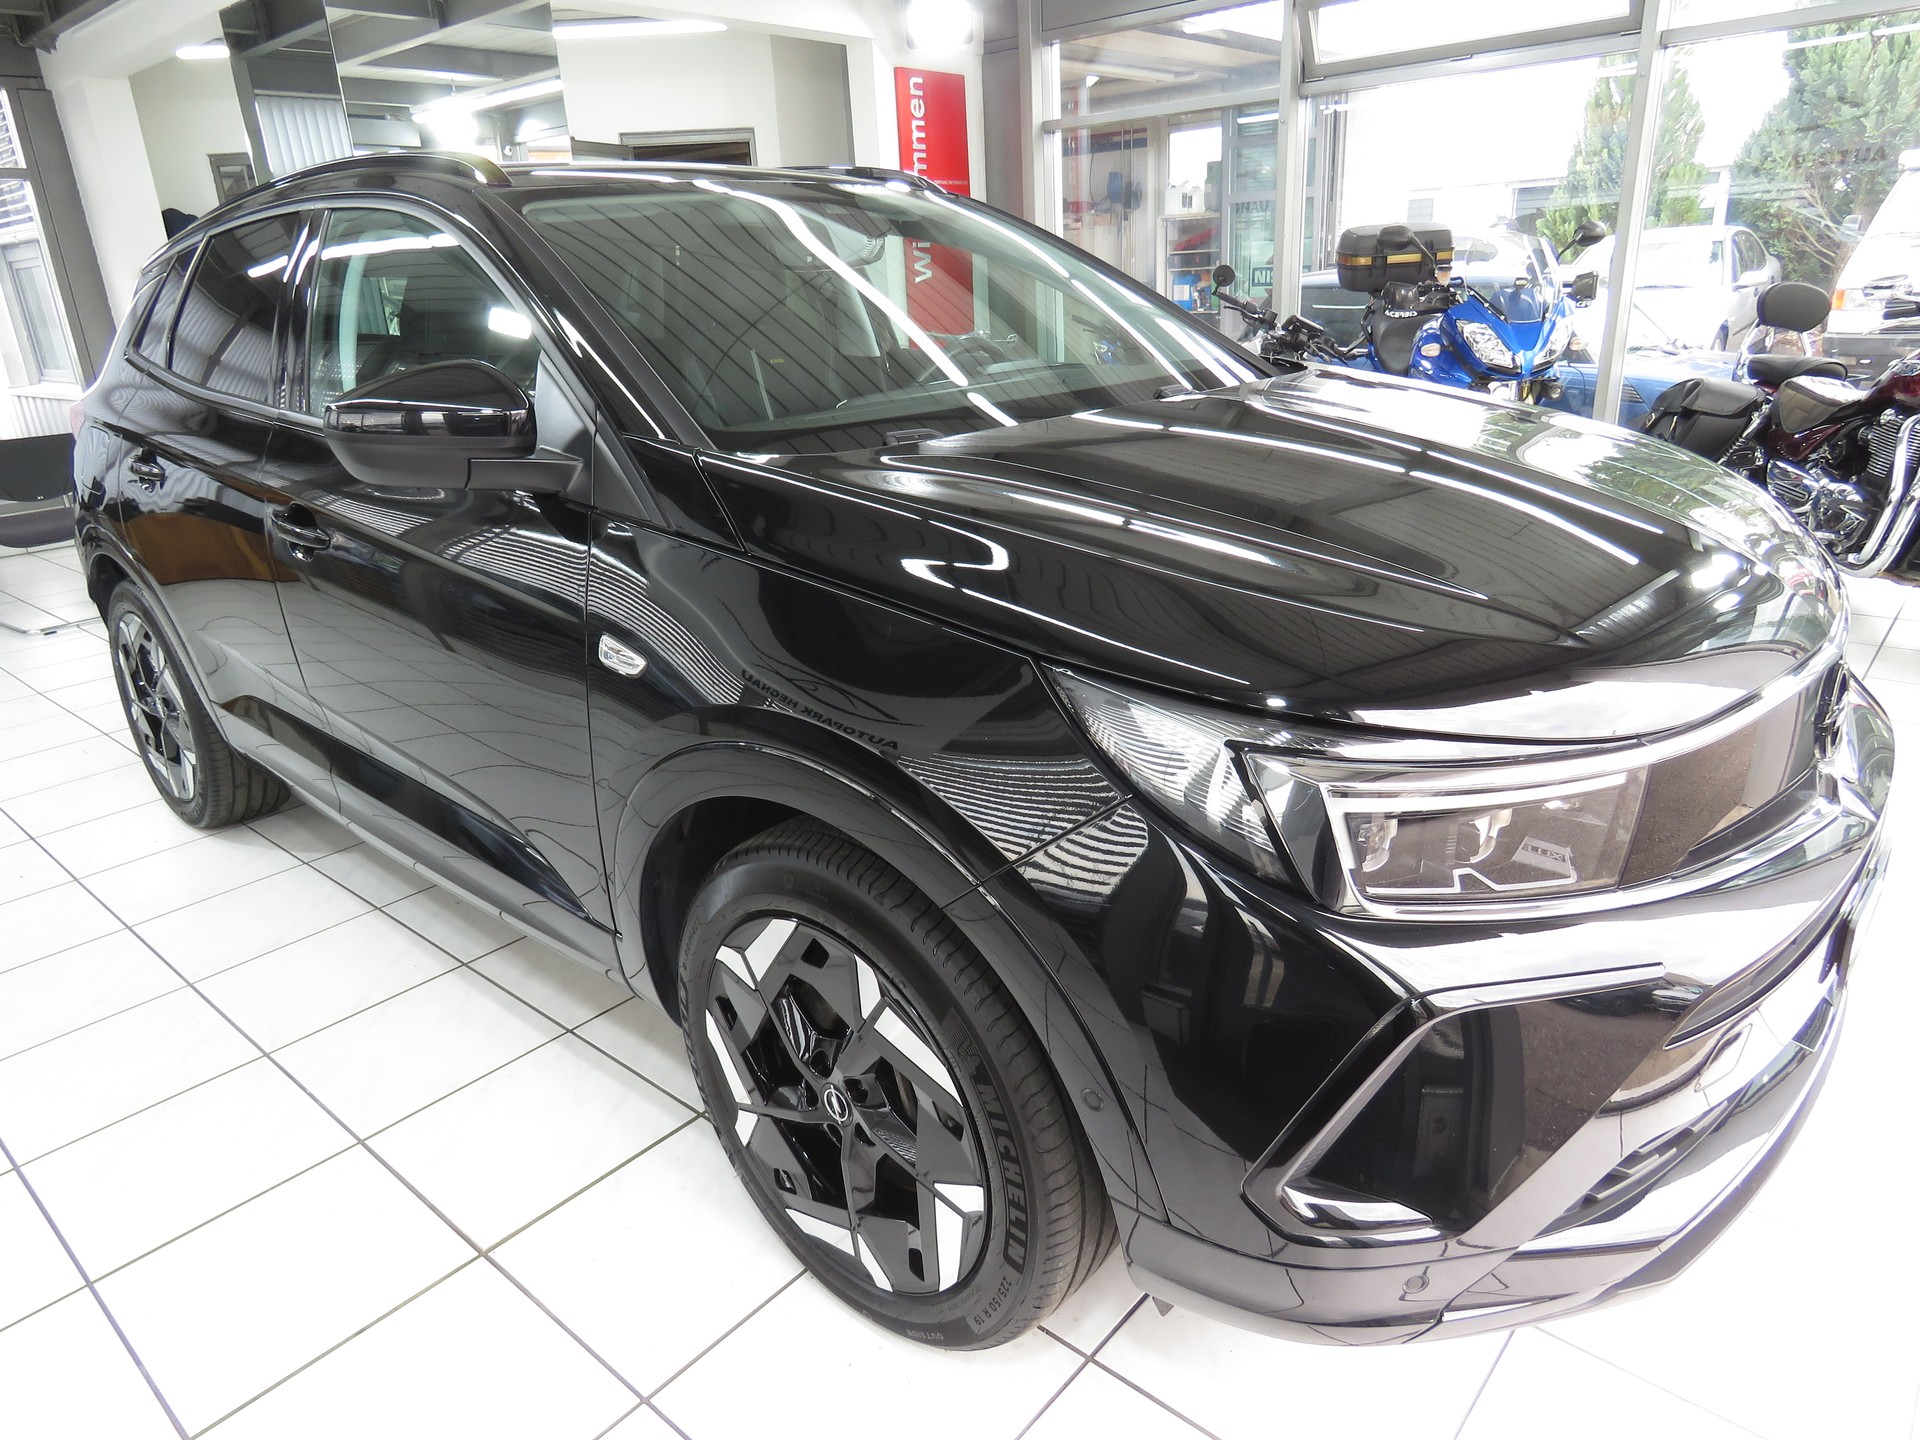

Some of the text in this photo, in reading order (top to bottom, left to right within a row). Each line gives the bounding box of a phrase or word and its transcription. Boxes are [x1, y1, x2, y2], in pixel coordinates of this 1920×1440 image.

[977, 1083, 1028, 1268] MICHELIN
[973, 1275, 1012, 1326] 225/50 R 19
